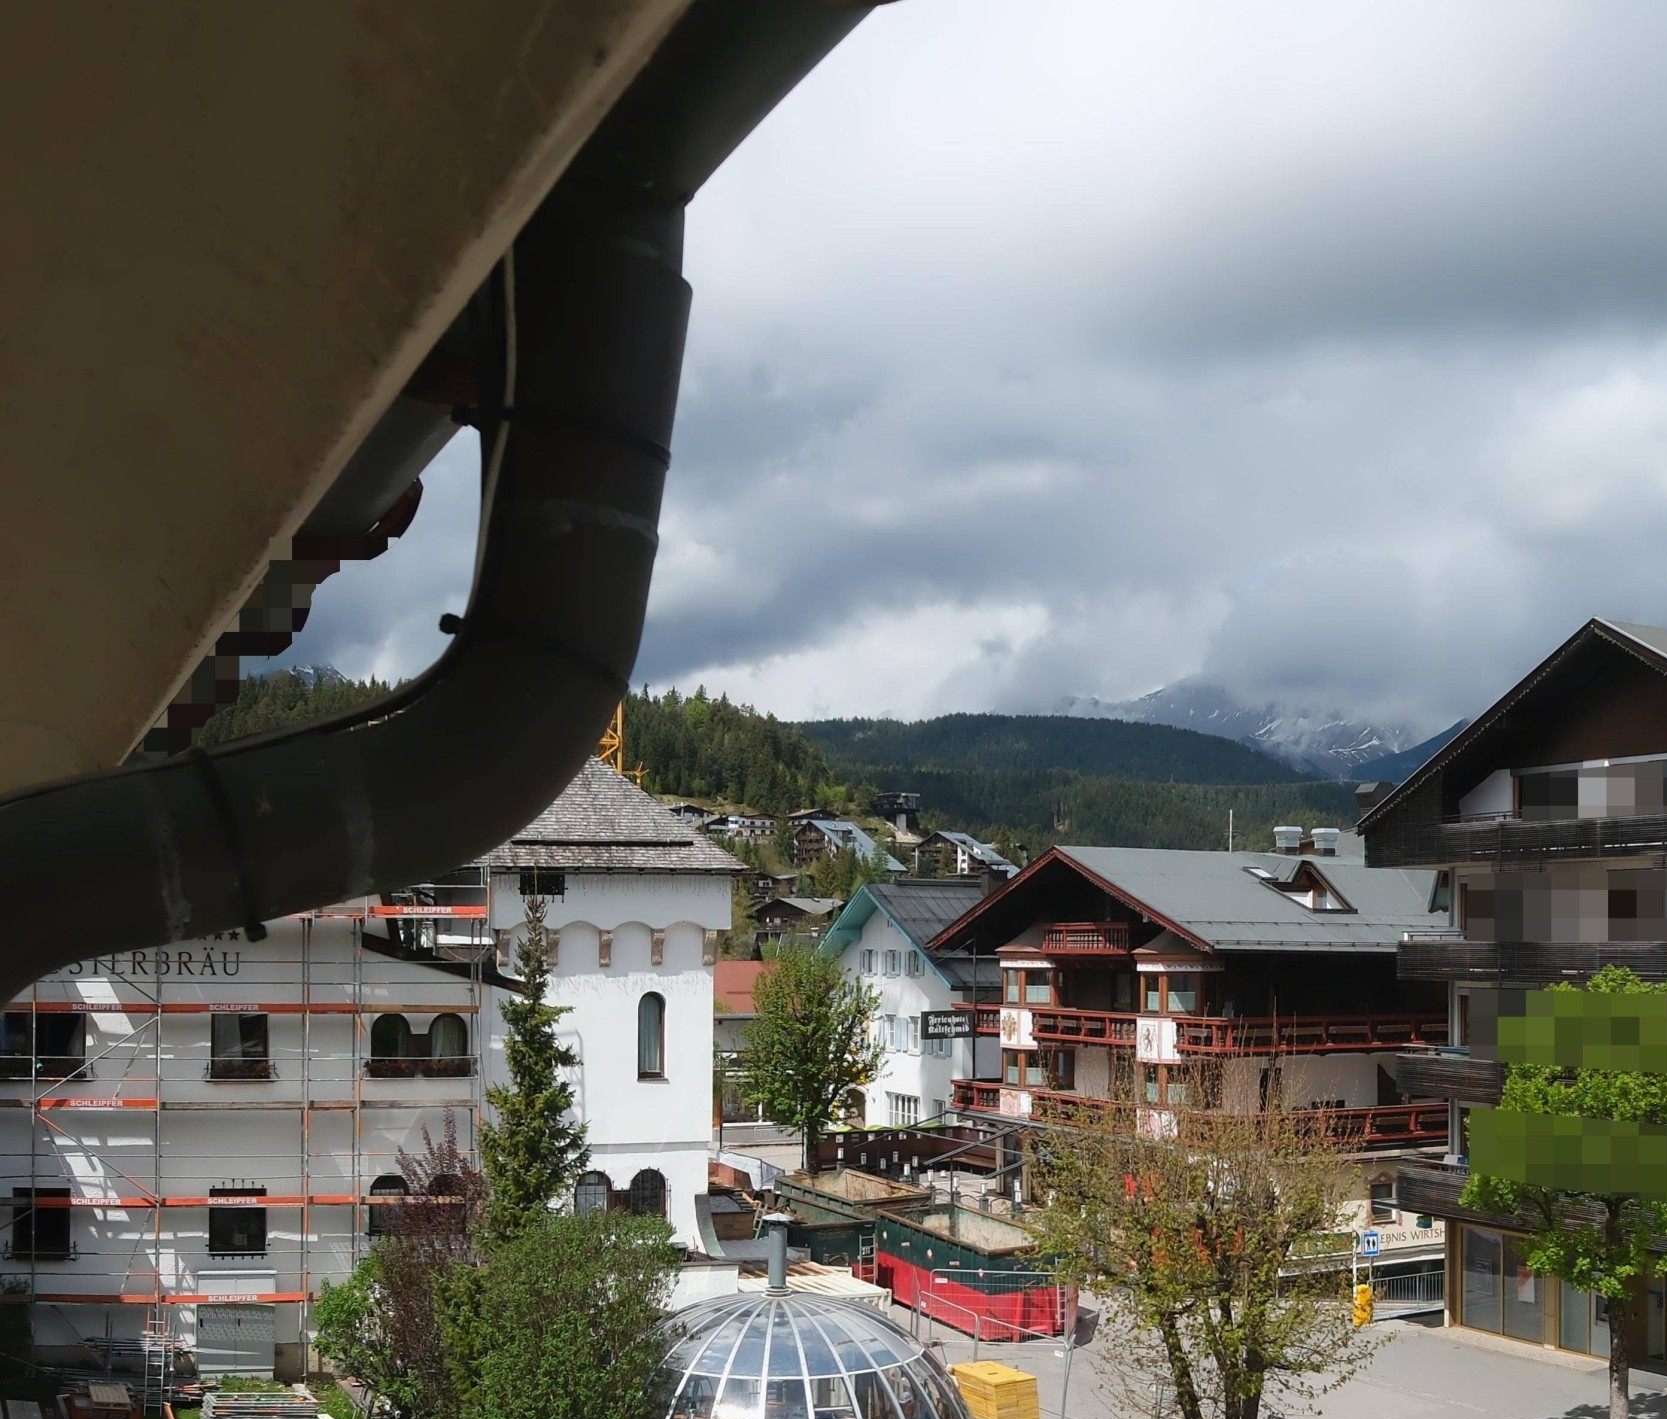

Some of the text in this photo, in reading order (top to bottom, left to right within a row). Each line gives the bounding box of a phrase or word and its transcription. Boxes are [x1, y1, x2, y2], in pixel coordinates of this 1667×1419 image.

[403, 906, 452, 914] SCHLEIPFER
[50, 947, 240, 976] STERBRÄU
[72, 1003, 122, 1011] SCHLEIPFER
[209, 1003, 259, 1011] SCHLEIPFER
[70, 1099, 123, 1107] SCHLEIPFER
[71, 1198, 121, 1206] SCHLEIPFER
[207, 1197, 258, 1205] SCHLEIPFER
[208, 1294, 258, 1302] SCHLEIPFER
